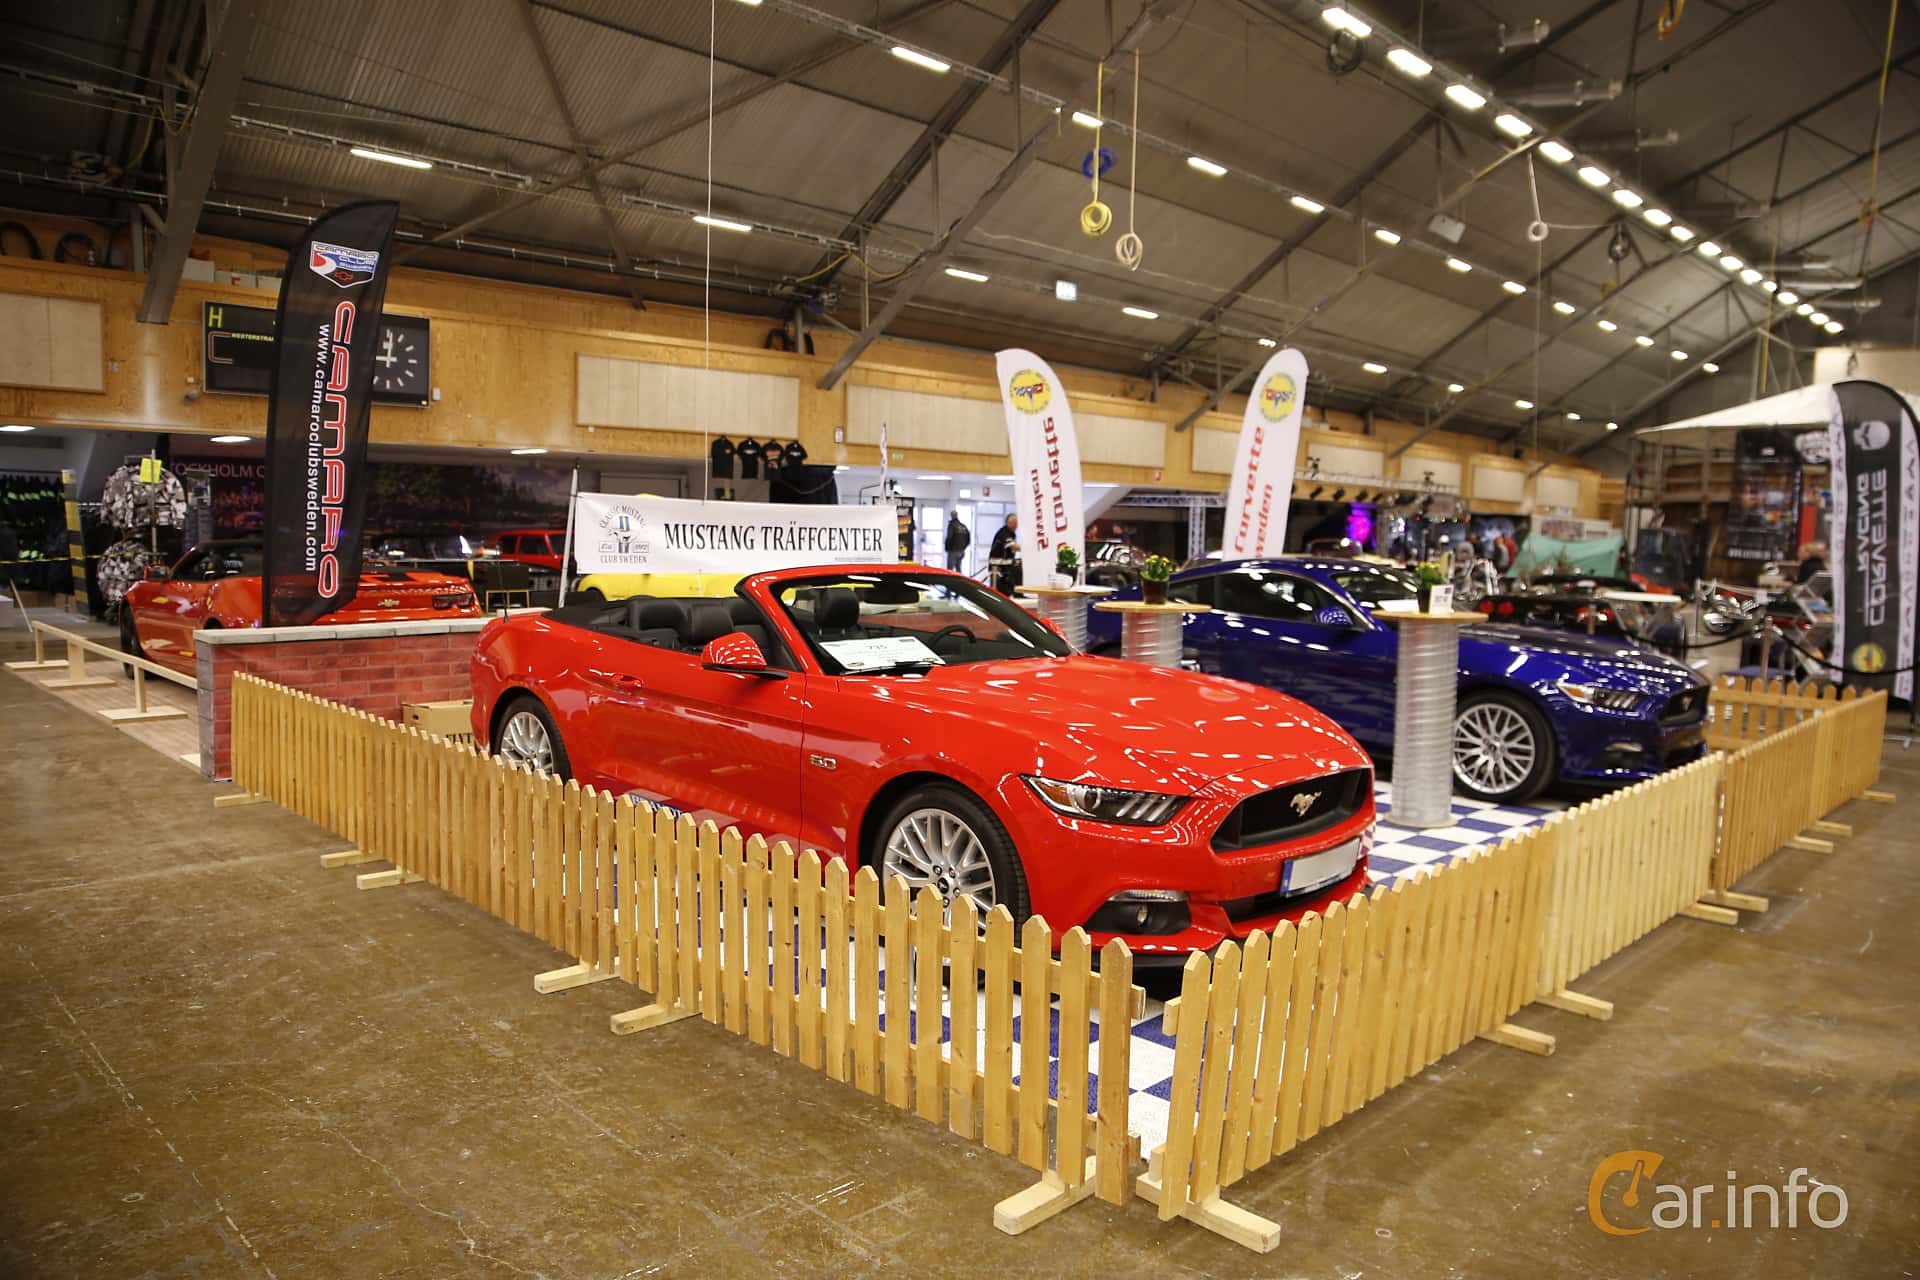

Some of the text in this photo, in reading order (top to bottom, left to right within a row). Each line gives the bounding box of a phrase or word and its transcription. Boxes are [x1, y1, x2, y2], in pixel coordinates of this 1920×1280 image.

[207, 306, 223, 329] H
[304, 323, 330, 572] www.camaroclubsweden.com
[317, 301, 356, 598] CAMARO
[664, 521, 882, 551] MUSTANG TRÄFFCENTER
